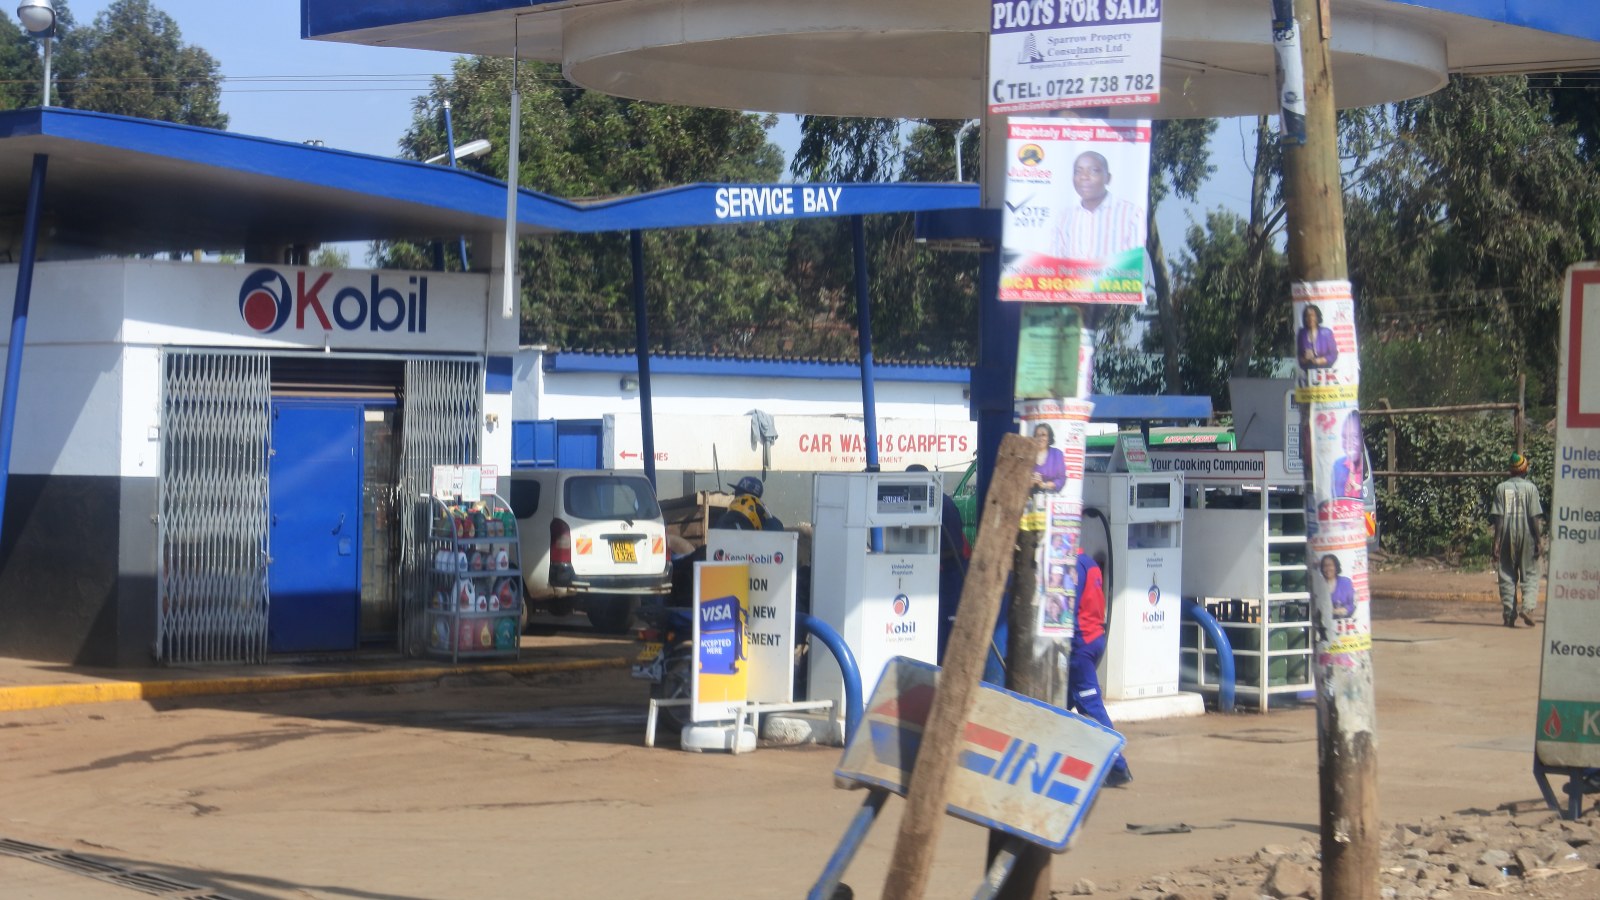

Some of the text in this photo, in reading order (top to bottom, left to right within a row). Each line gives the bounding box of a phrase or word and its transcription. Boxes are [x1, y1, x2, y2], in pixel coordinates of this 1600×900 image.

[993, 0, 1159, 29] PLOTS FOR SALE
[1047, 32, 1132, 46] Sparrow Property
[1047, 43, 1123, 57] Consultants Ltd
[1008, 73, 1154, 99] TEL: 0722 738 782
[715, 187, 842, 219] SERVICE BAY
[296, 271, 428, 333] Kobil
[800, 434, 832, 453] CAR
[840, 434, 882, 453] WAH
[898, 434, 968, 453] CARPETS
[640, 452, 669, 462] LIES
[1151, 458, 1264, 474] Your Cooking Companion
[1556, 570, 1577, 580] Low
[701, 604, 732, 622] VISA
[753, 606, 776, 619] NEW
[1142, 610, 1165, 623] Kobil
[886, 621, 916, 634] Kobil
[701, 638, 732, 648] ACCEPTED
[992, 737, 1064, 794] IN
